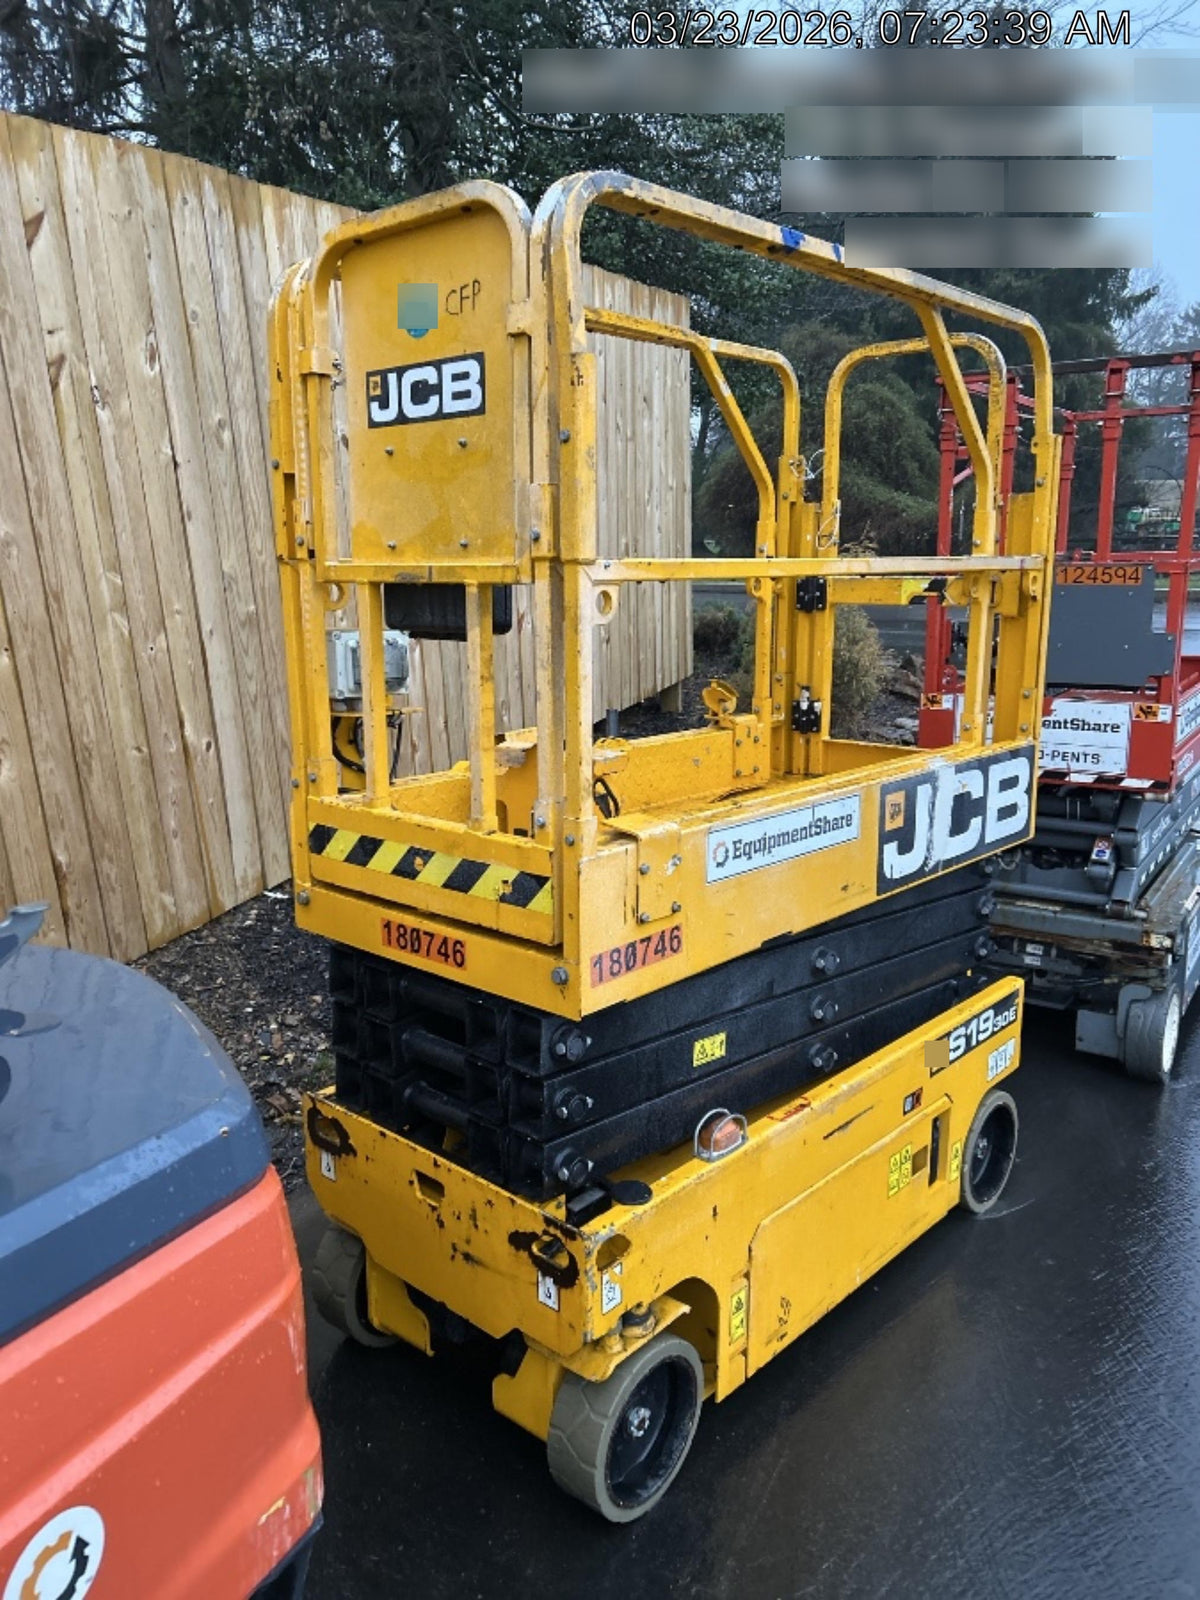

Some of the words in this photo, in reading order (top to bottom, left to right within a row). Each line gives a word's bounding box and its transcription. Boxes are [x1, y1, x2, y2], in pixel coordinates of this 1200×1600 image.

[445, 278, 481, 316] CFP
[369, 358, 483, 423] JCB
[1059, 566, 1142, 585] 124594
[1041, 717, 1121, 734] entShare
[732, 812, 853, 861] EquipmentShare
[883, 756, 1031, 880] JCB
[382, 919, 466, 969] 180746
[593, 925, 682, 984] 180746
